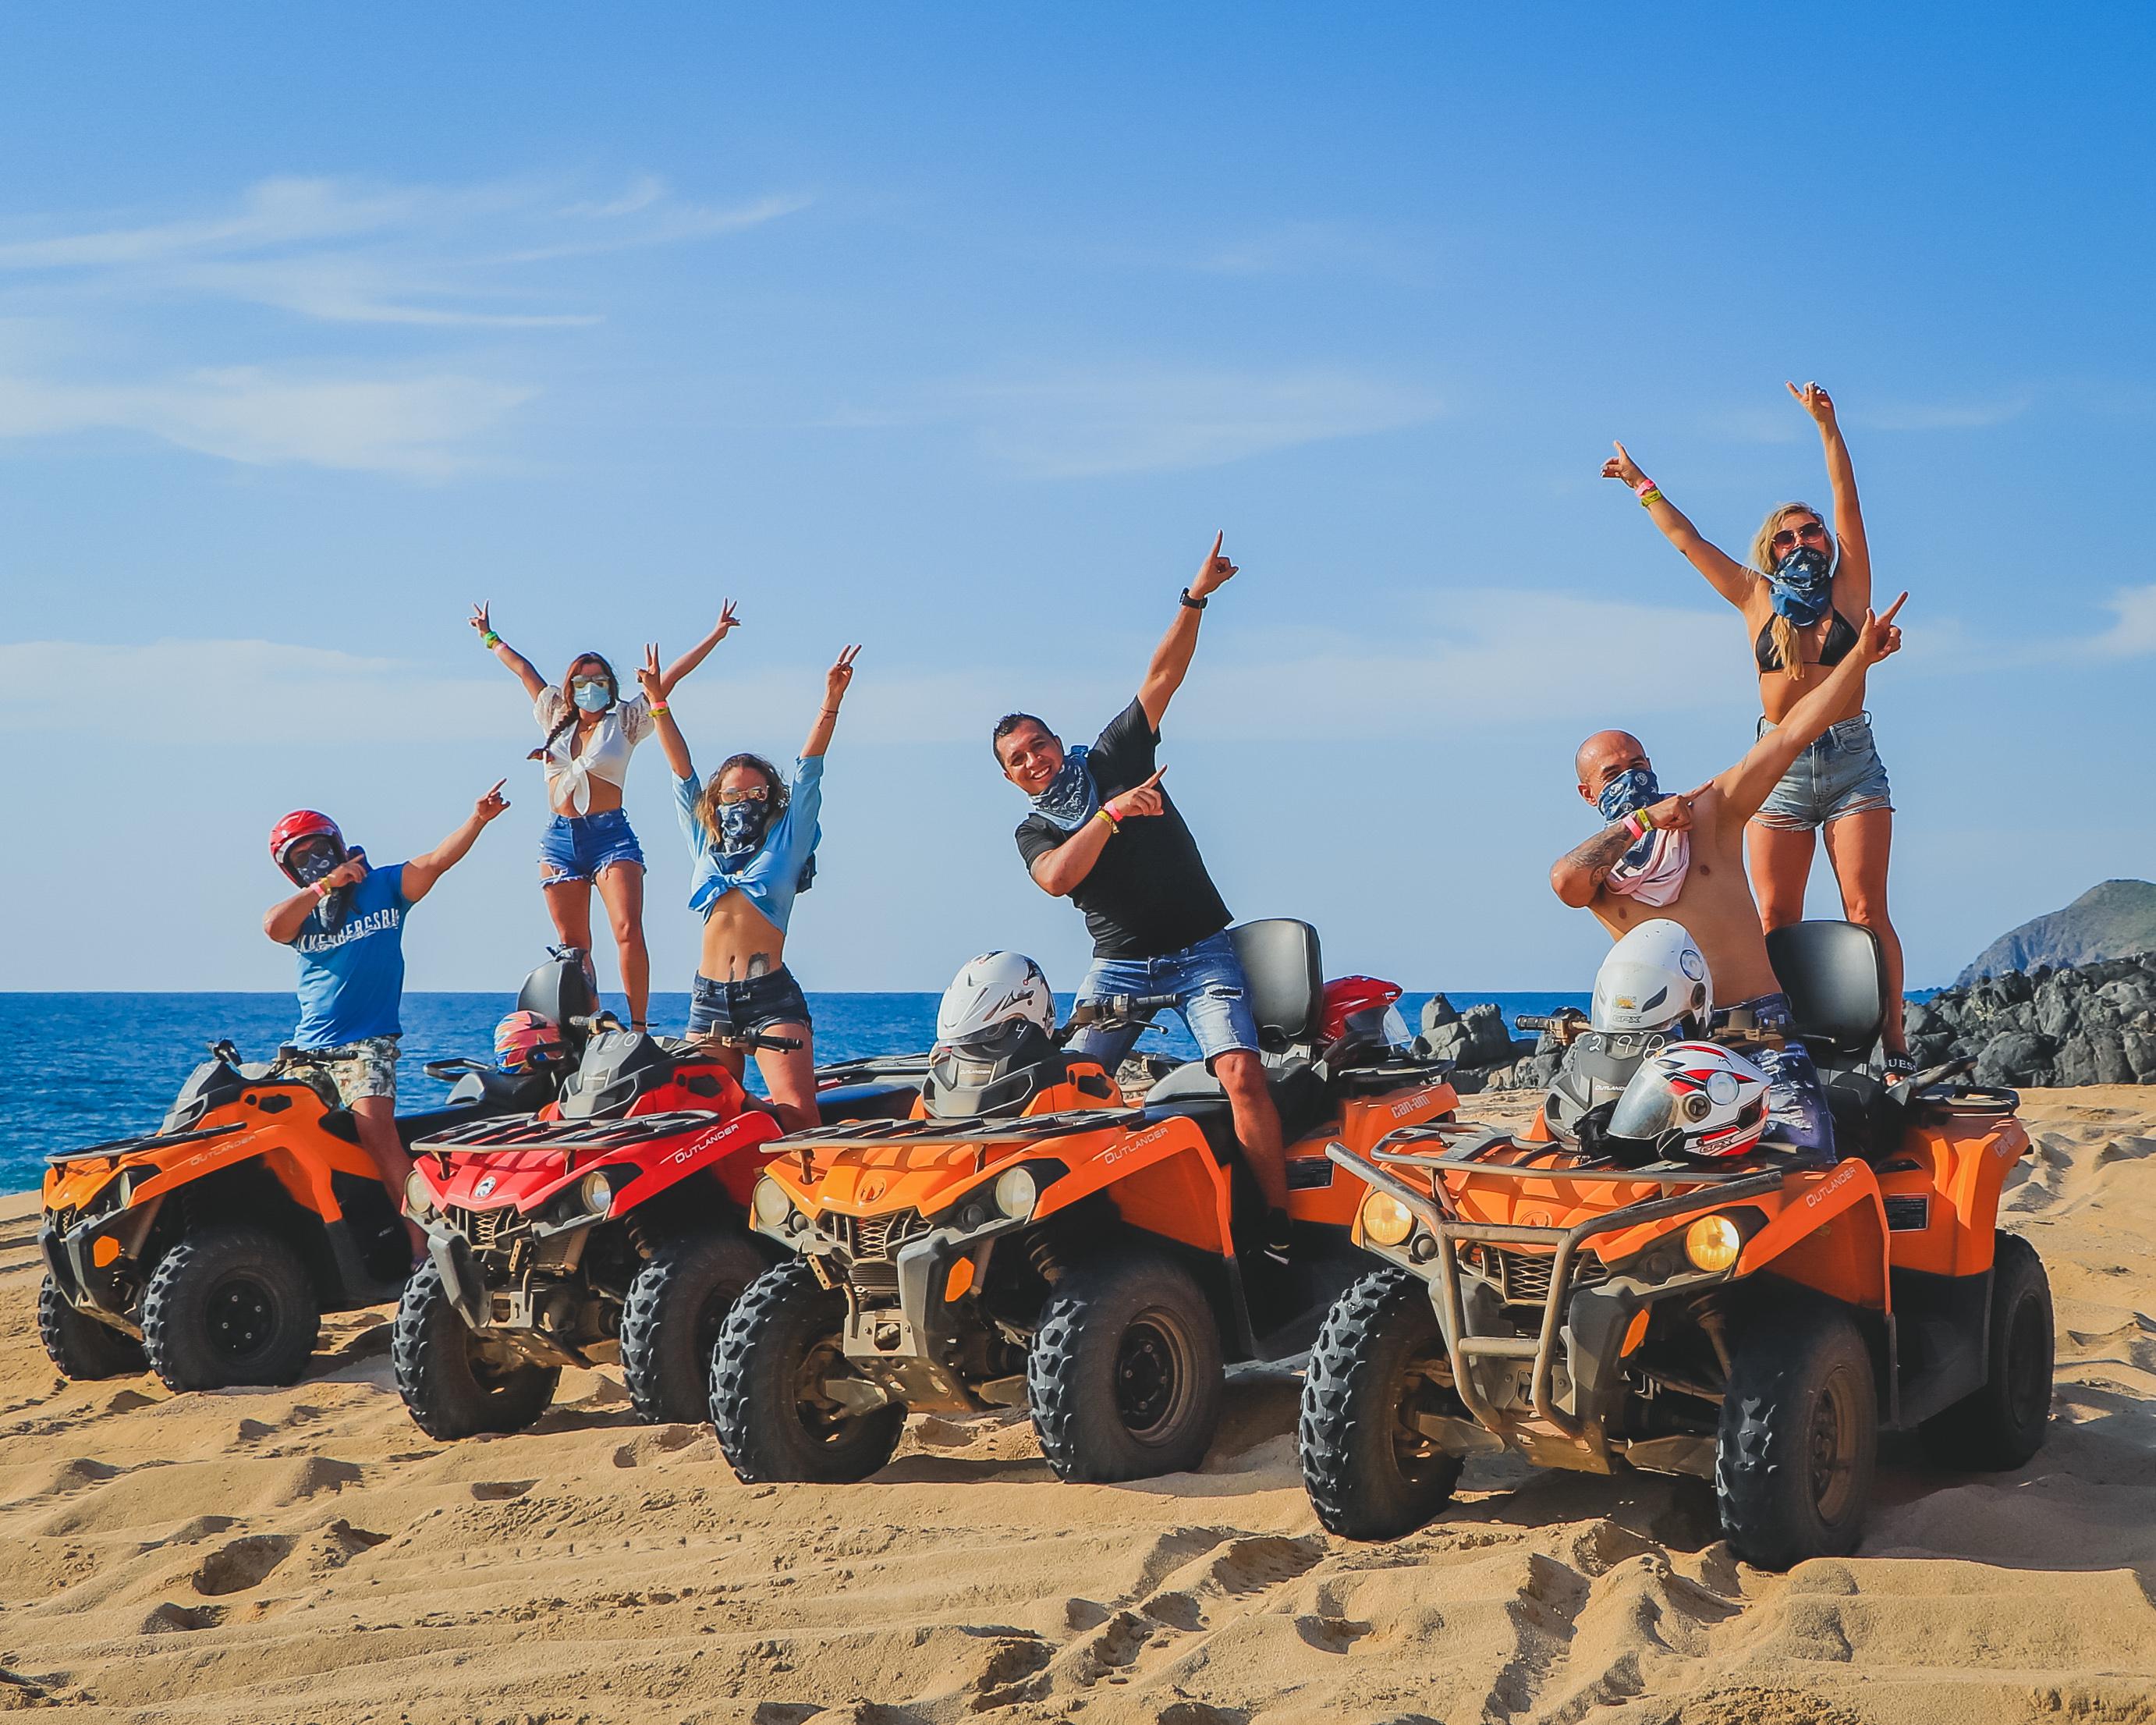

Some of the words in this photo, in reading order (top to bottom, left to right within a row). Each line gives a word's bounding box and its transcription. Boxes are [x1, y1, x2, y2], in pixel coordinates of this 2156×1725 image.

[190, 1134, 257, 1166] OUTLANDER
[675, 1123, 739, 1164] OUTLANDER
[1105, 1127, 1169, 1165] OUTLANDER
[1806, 1166, 1857, 1208] OUTLANDER
